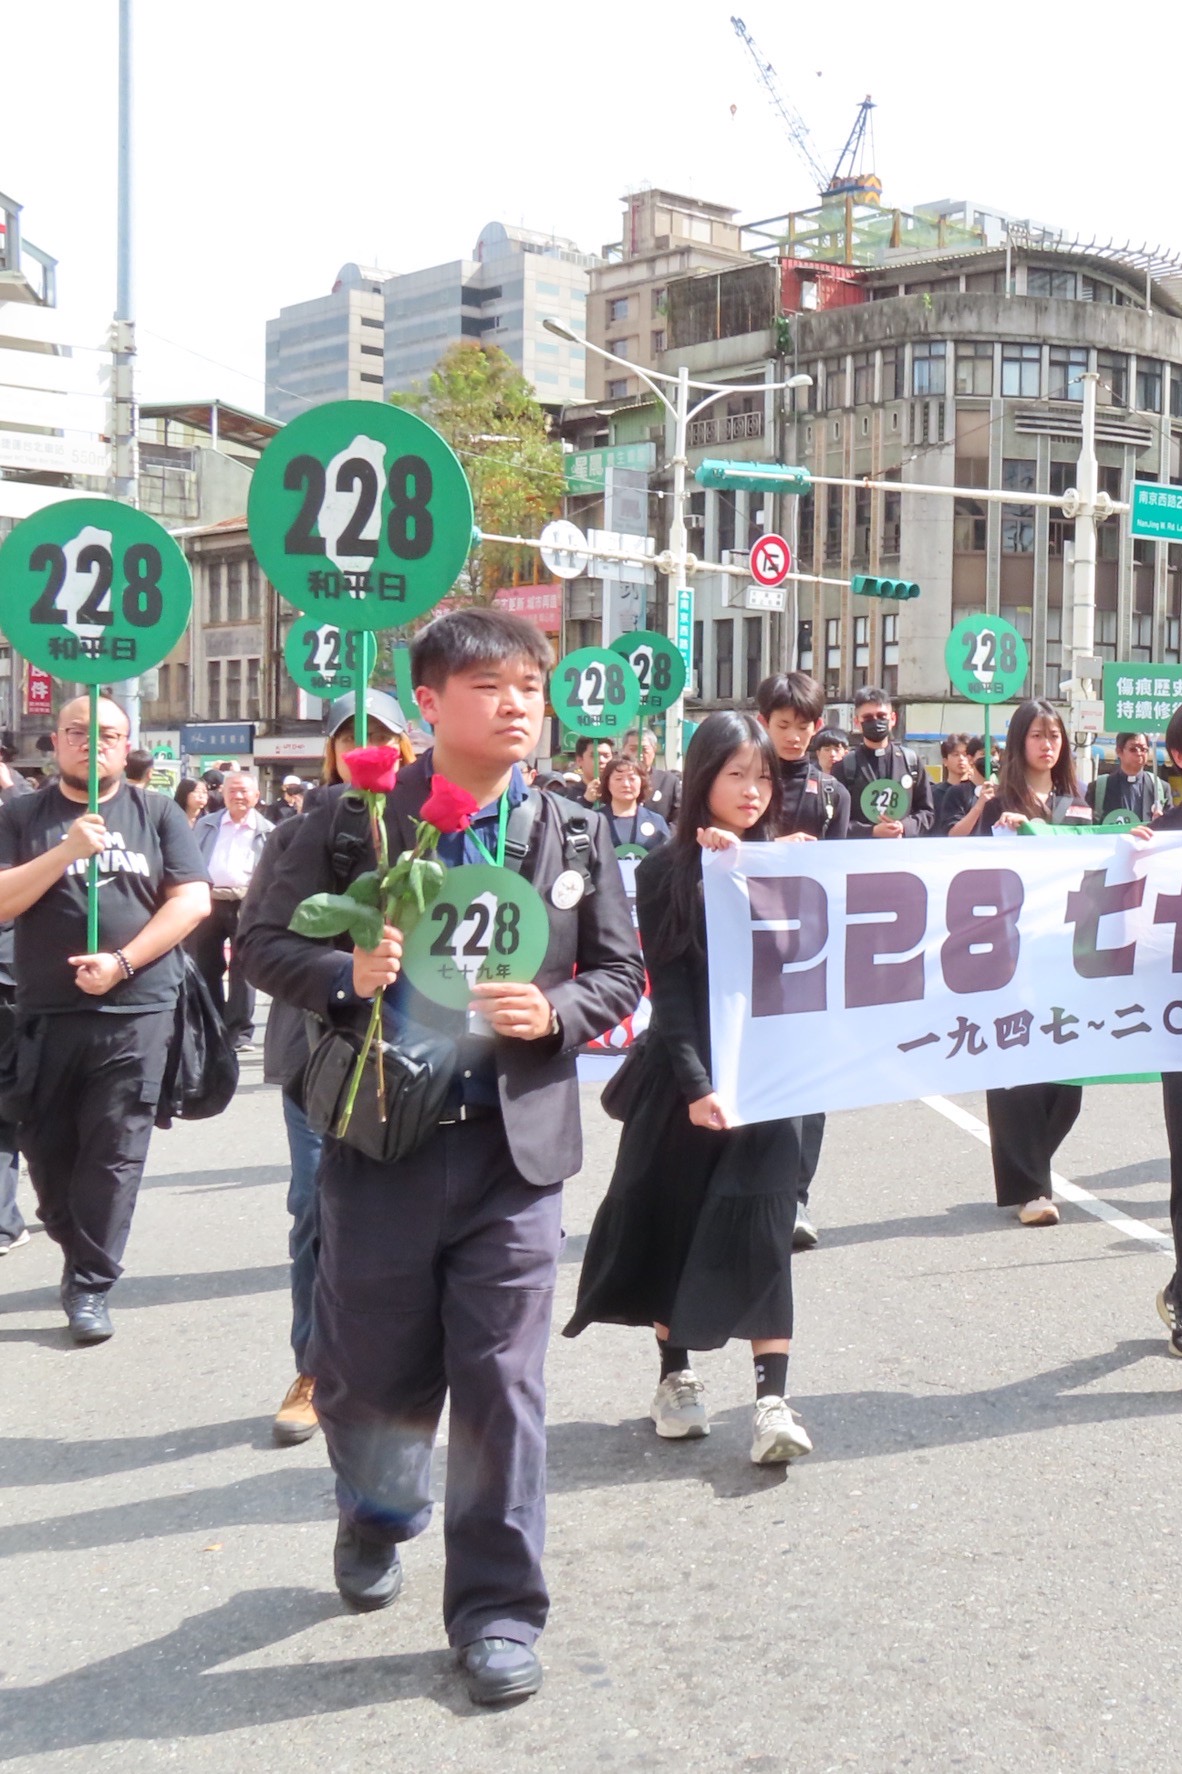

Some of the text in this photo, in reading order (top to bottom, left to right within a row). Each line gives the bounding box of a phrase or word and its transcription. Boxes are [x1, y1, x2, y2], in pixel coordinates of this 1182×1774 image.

[283, 455, 434, 560] 228
[28, 543, 163, 627] 228
[308, 570, 406, 602] 和平日
[49, 637, 137, 662] 和平日
[961, 631, 1017, 674] 228
[564, 663, 626, 707] 228
[619, 652, 671, 691] 28
[968, 682, 1004, 694] 和平日
[577, 714, 617, 727] 和平日
[870, 789, 899, 808] 228
[429, 901, 521, 956] 228
[747, 868, 1025, 1018] 228
[437, 963, 511, 980] 七十九年
